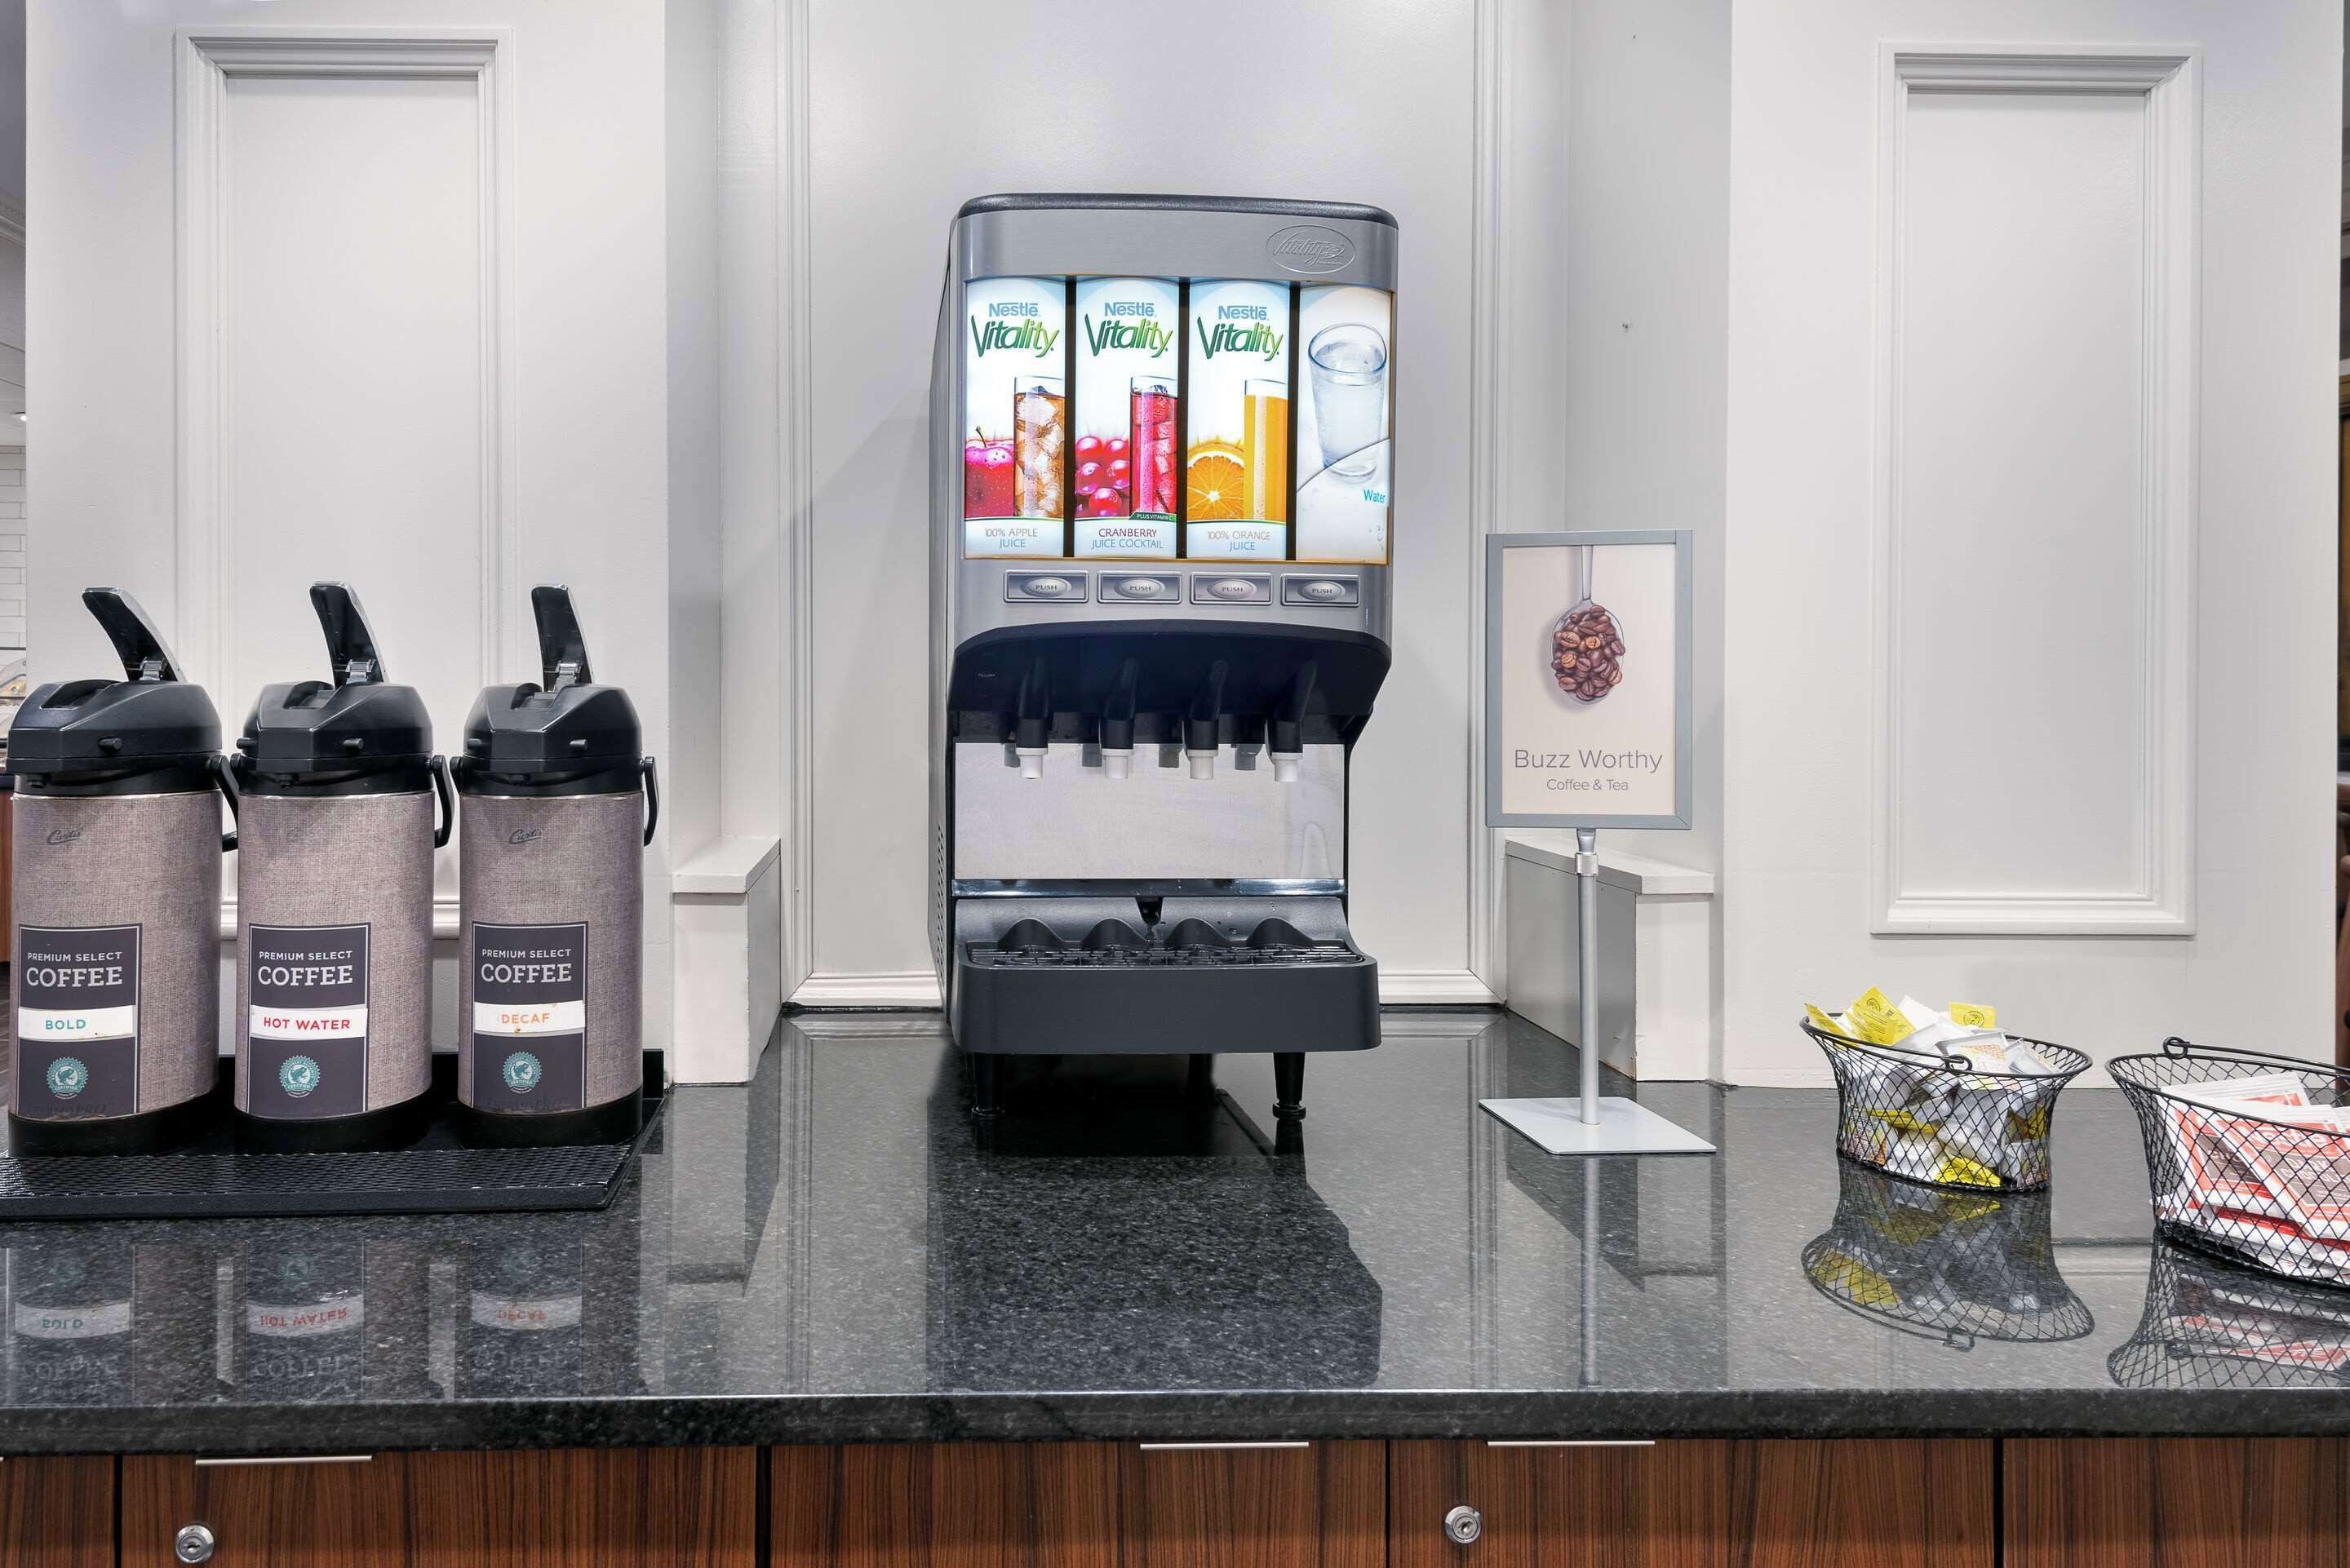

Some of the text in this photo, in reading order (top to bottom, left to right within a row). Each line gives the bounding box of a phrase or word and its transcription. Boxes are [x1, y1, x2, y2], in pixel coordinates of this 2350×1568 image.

[971, 314, 1060, 357] Vitality
[1084, 313, 1173, 358] Vitality
[1197, 317, 1284, 361] Vitality
[1363, 489, 1386, 503] Water
[1009, 528, 1038, 538] APPLE
[1098, 529, 1157, 538] CRANBERRY
[1232, 530, 1271, 540] ORANGE
[999, 538, 1026, 548] JUICE
[1092, 539, 1164, 549] JUICE COCKTAIL
[1229, 541, 1256, 551] JUICE
[1514, 749, 1663, 773] Buzz Worthy
[1546, 778, 1629, 791] Coffee & Tea
[28, 951, 123, 962] PREMIUM SELECT
[259, 950, 353, 961] PREMIUM SELECT
[482, 949, 572, 958] PREMIUM SELECT
[26, 966, 123, 987] COFFEE
[258, 964, 353, 986] COFFEE
[481, 963, 572, 983] COFFEE
[264, 1017, 351, 1030] HOT WATER
[501, 1012, 550, 1024] DECAF
[45, 1019, 86, 1030] BOLD
